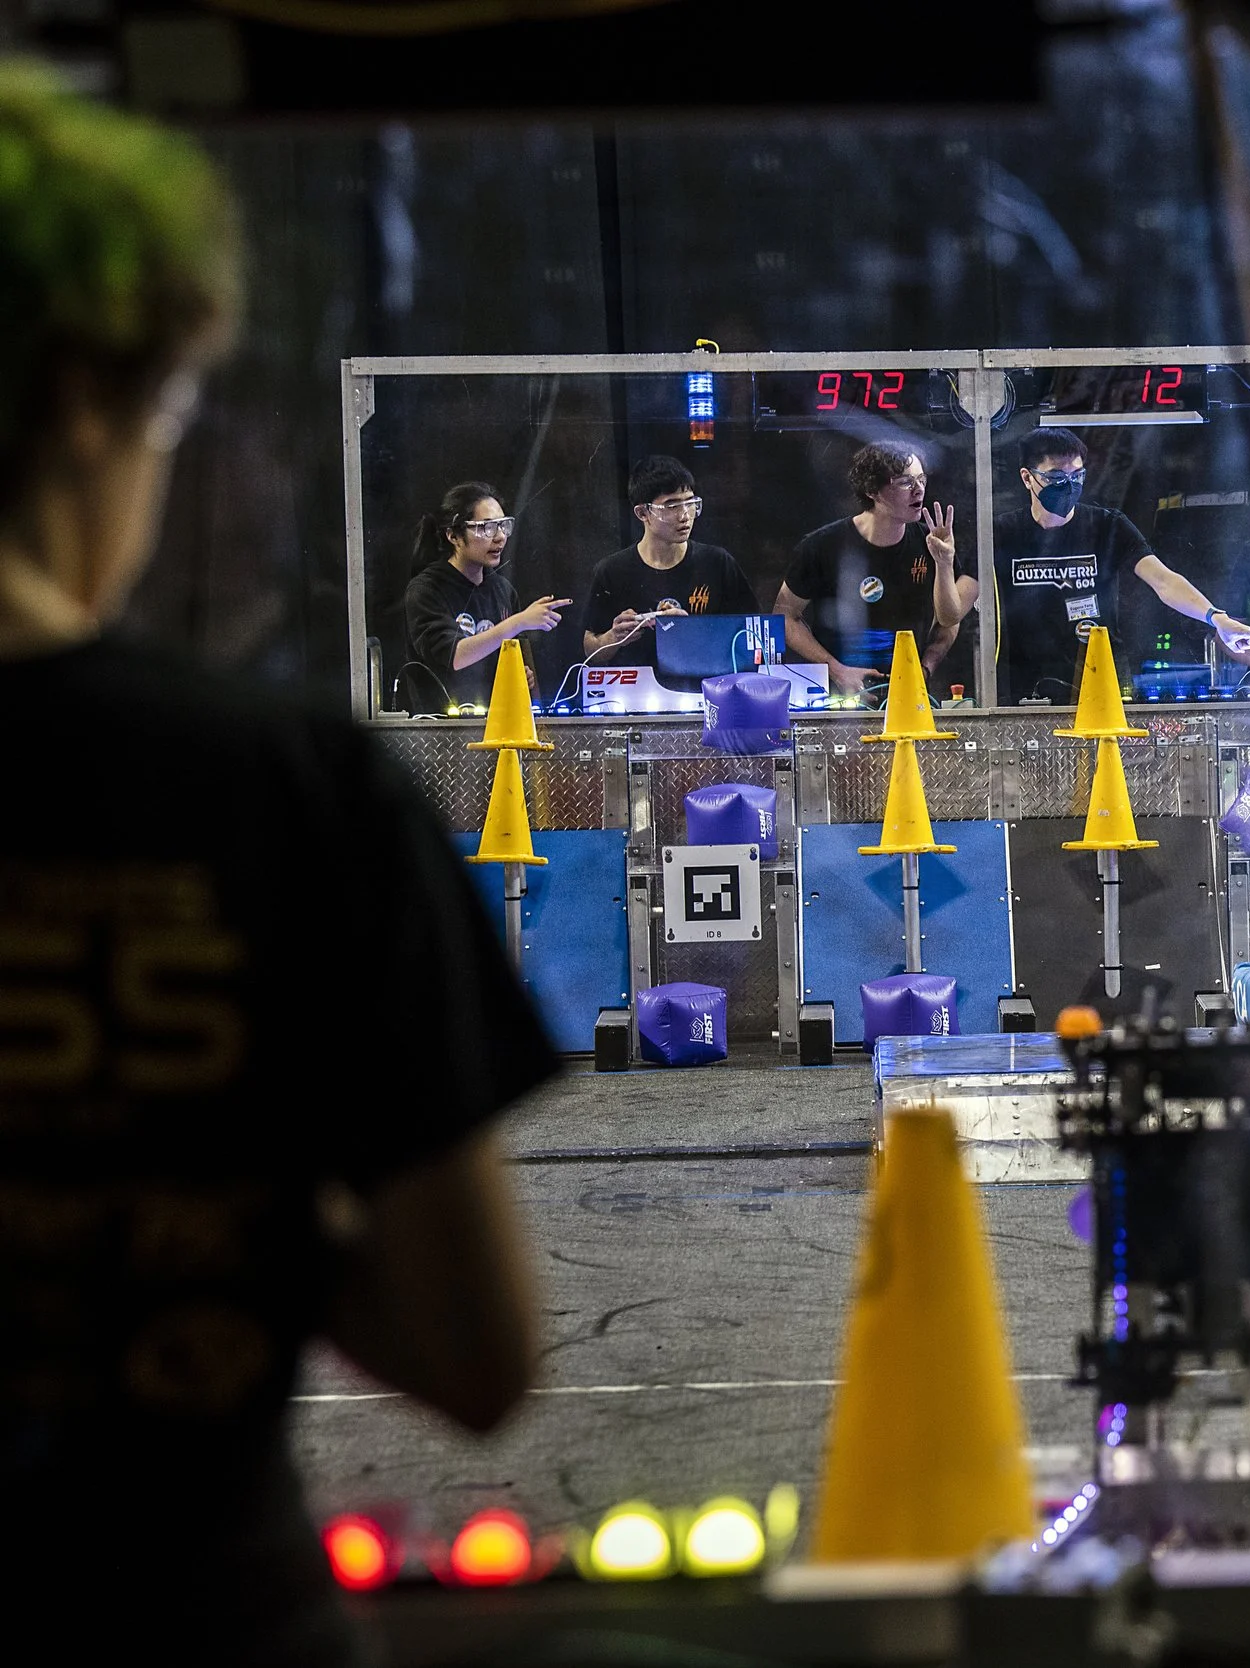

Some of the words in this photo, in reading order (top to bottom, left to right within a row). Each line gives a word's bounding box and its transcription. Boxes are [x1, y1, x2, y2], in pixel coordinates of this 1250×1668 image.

[816, 371, 904, 410] 972
[1141, 367, 1183, 404] 12
[1075, 577, 1095, 589] 604
[587, 670, 638, 685] 972
[758, 809, 766, 840] FIRST
[706, 930, 715, 938] ID
[716, 930, 722, 938] 8
[704, 1013, 713, 1045] FIRST
